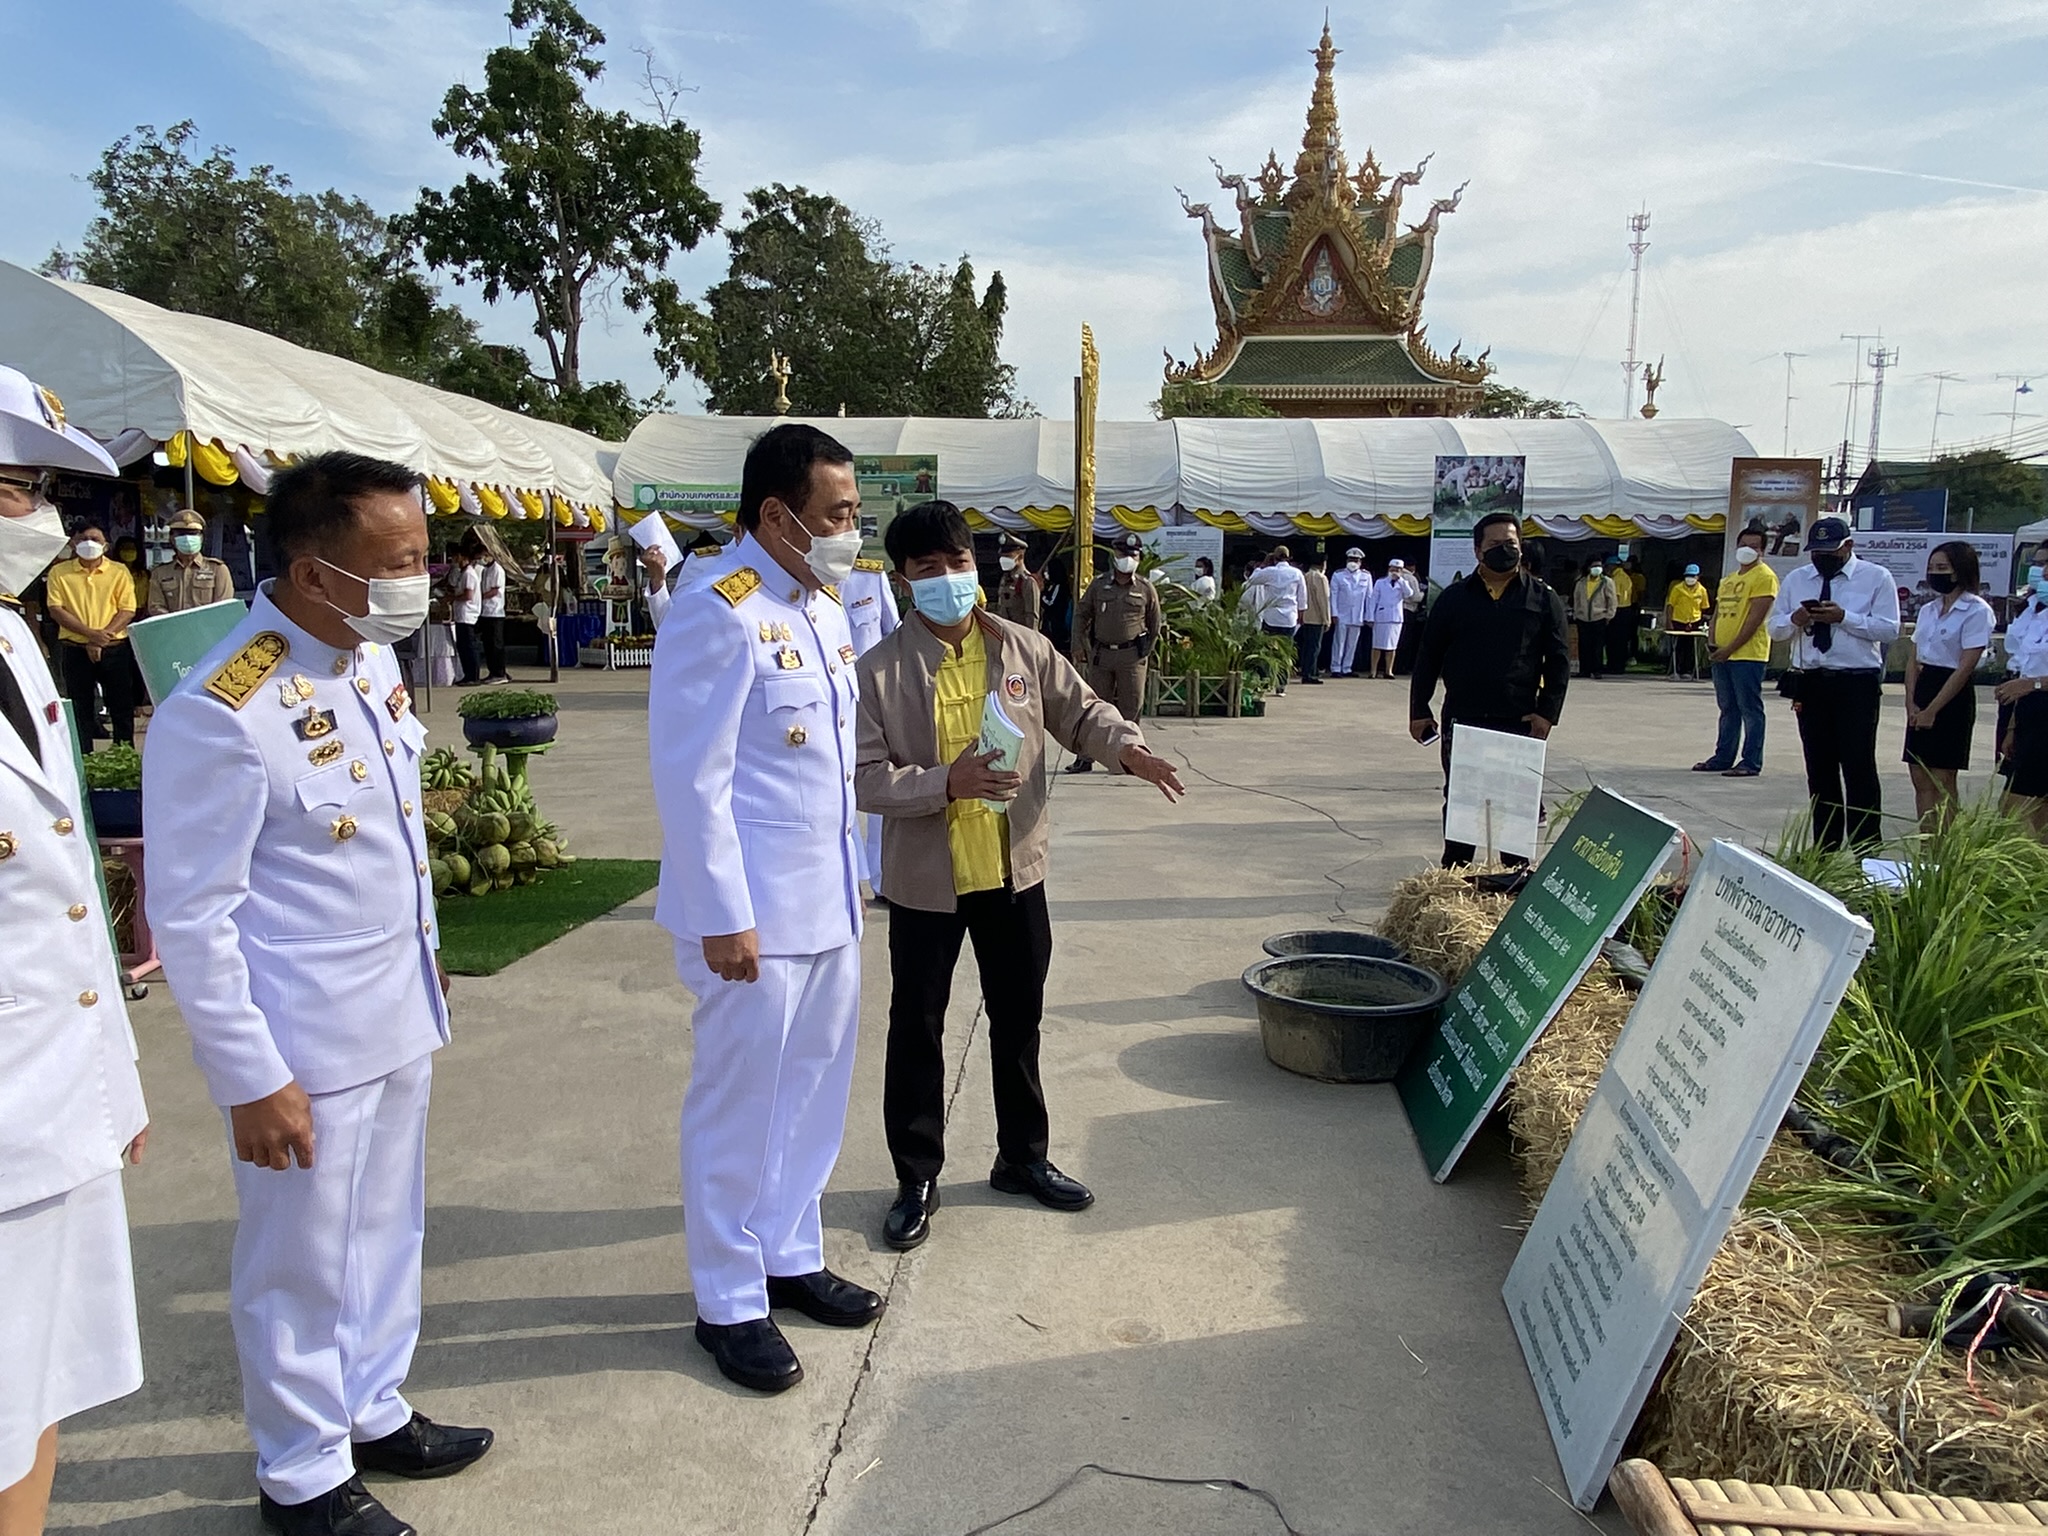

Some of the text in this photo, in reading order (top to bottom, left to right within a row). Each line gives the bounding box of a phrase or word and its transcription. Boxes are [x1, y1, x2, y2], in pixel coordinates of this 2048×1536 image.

[1715, 874, 1807, 951] บทพิจารณาอาหาร
